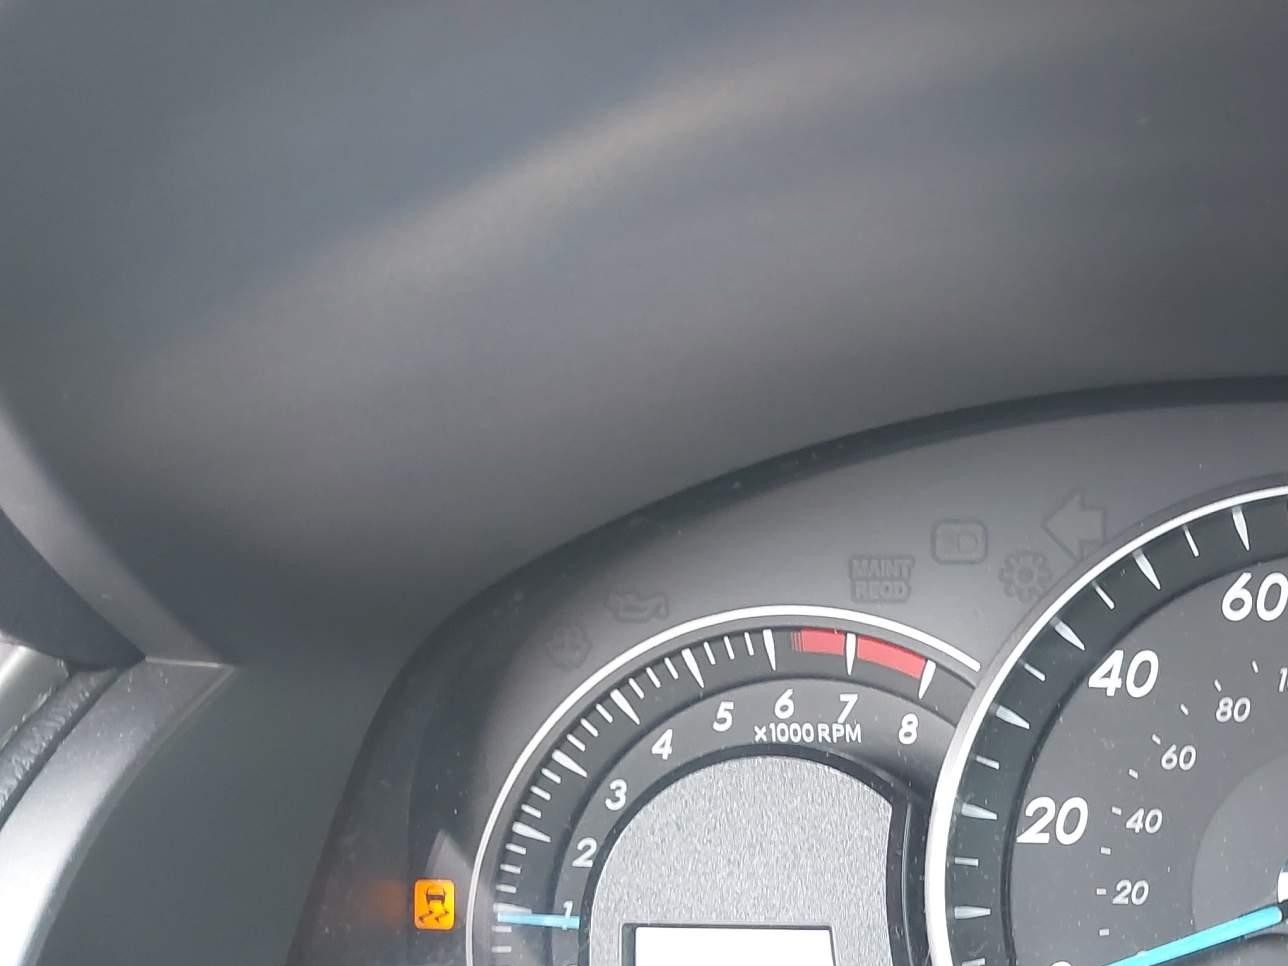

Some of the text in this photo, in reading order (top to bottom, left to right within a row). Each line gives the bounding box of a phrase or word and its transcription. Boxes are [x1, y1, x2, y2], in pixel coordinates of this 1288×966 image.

[1222, 573, 1288, 621] 60
[1089, 650, 1158, 697] 40
[713, 702, 733, 731] 5
[775, 689, 794, 718] 6
[838, 694, 858, 723] 7
[1216, 698, 1250, 721] 80
[899, 714, 918, 744] 8
[652, 729, 672, 759] 4
[1161, 745, 1196, 770] 60
[606, 780, 626, 810] 3
[1017, 797, 1088, 844] 20
[1126, 809, 1162, 833] 40
[573, 838, 596, 867] 2
[1113, 880, 1148, 904] 20
[563, 901, 574, 930] 1
